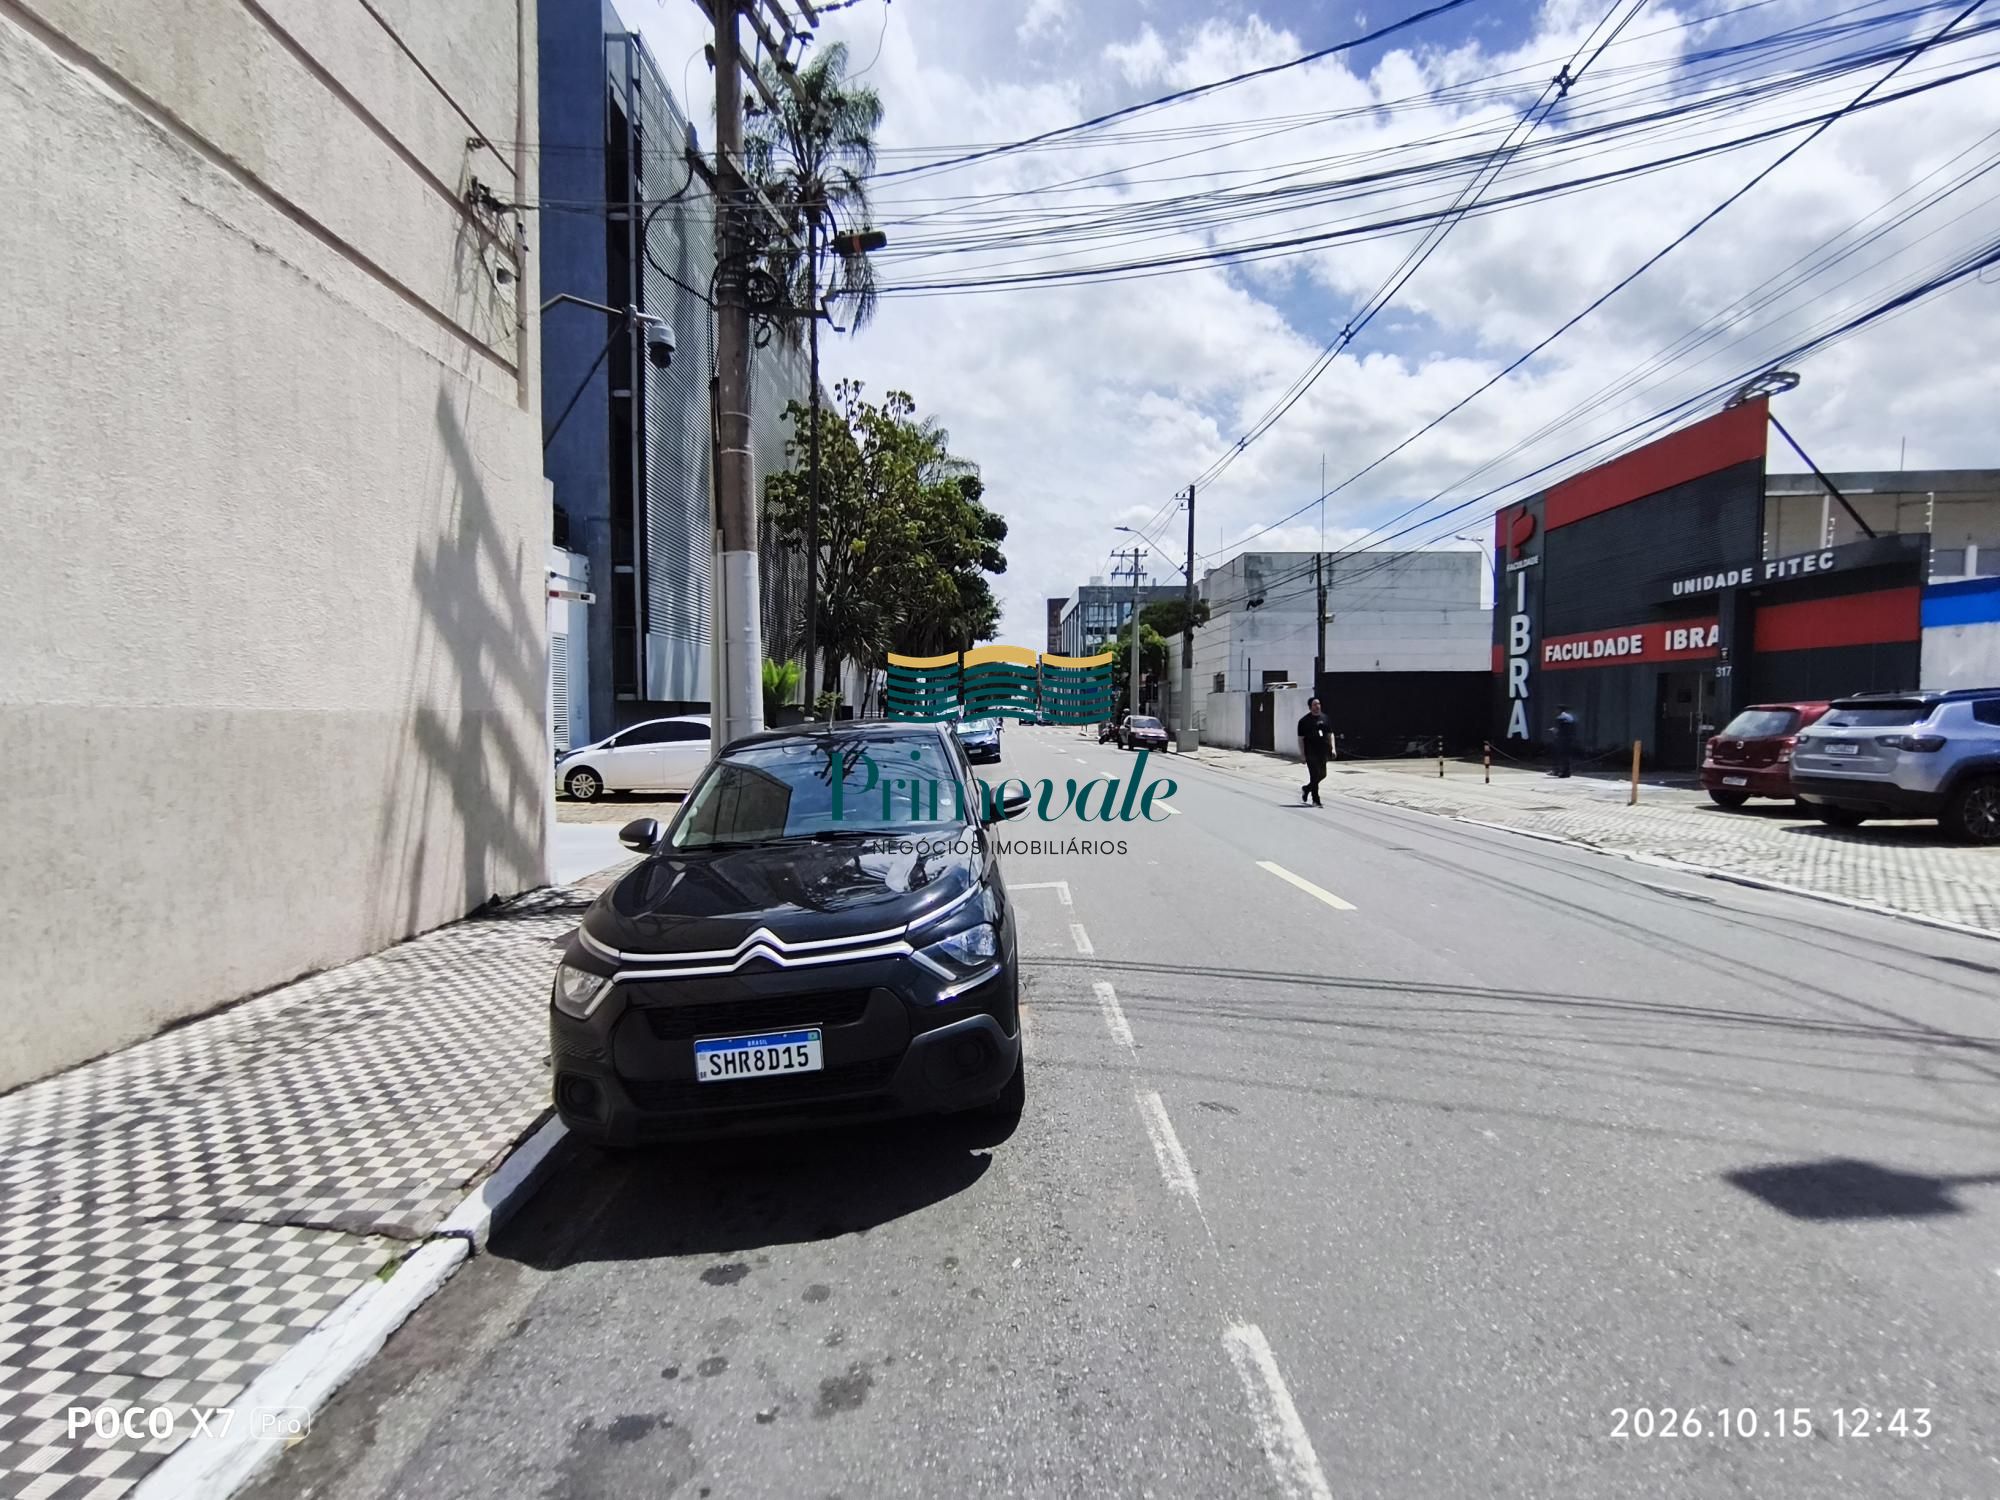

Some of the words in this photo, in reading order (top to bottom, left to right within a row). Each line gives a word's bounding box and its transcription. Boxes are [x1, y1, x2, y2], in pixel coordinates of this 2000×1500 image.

[1672, 568, 1753, 596] UNIDADE
[1765, 552, 1834, 580] FITEC
[1506, 571, 1531, 740] IBRA
[1545, 634, 1643, 662] FACULDADE
[1664, 625, 1719, 650] IBRA
[1715, 665, 1732, 678] 317
[747, 1039, 768, 1047] BRASIL
[709, 1045, 809, 1077] SHR8D15
